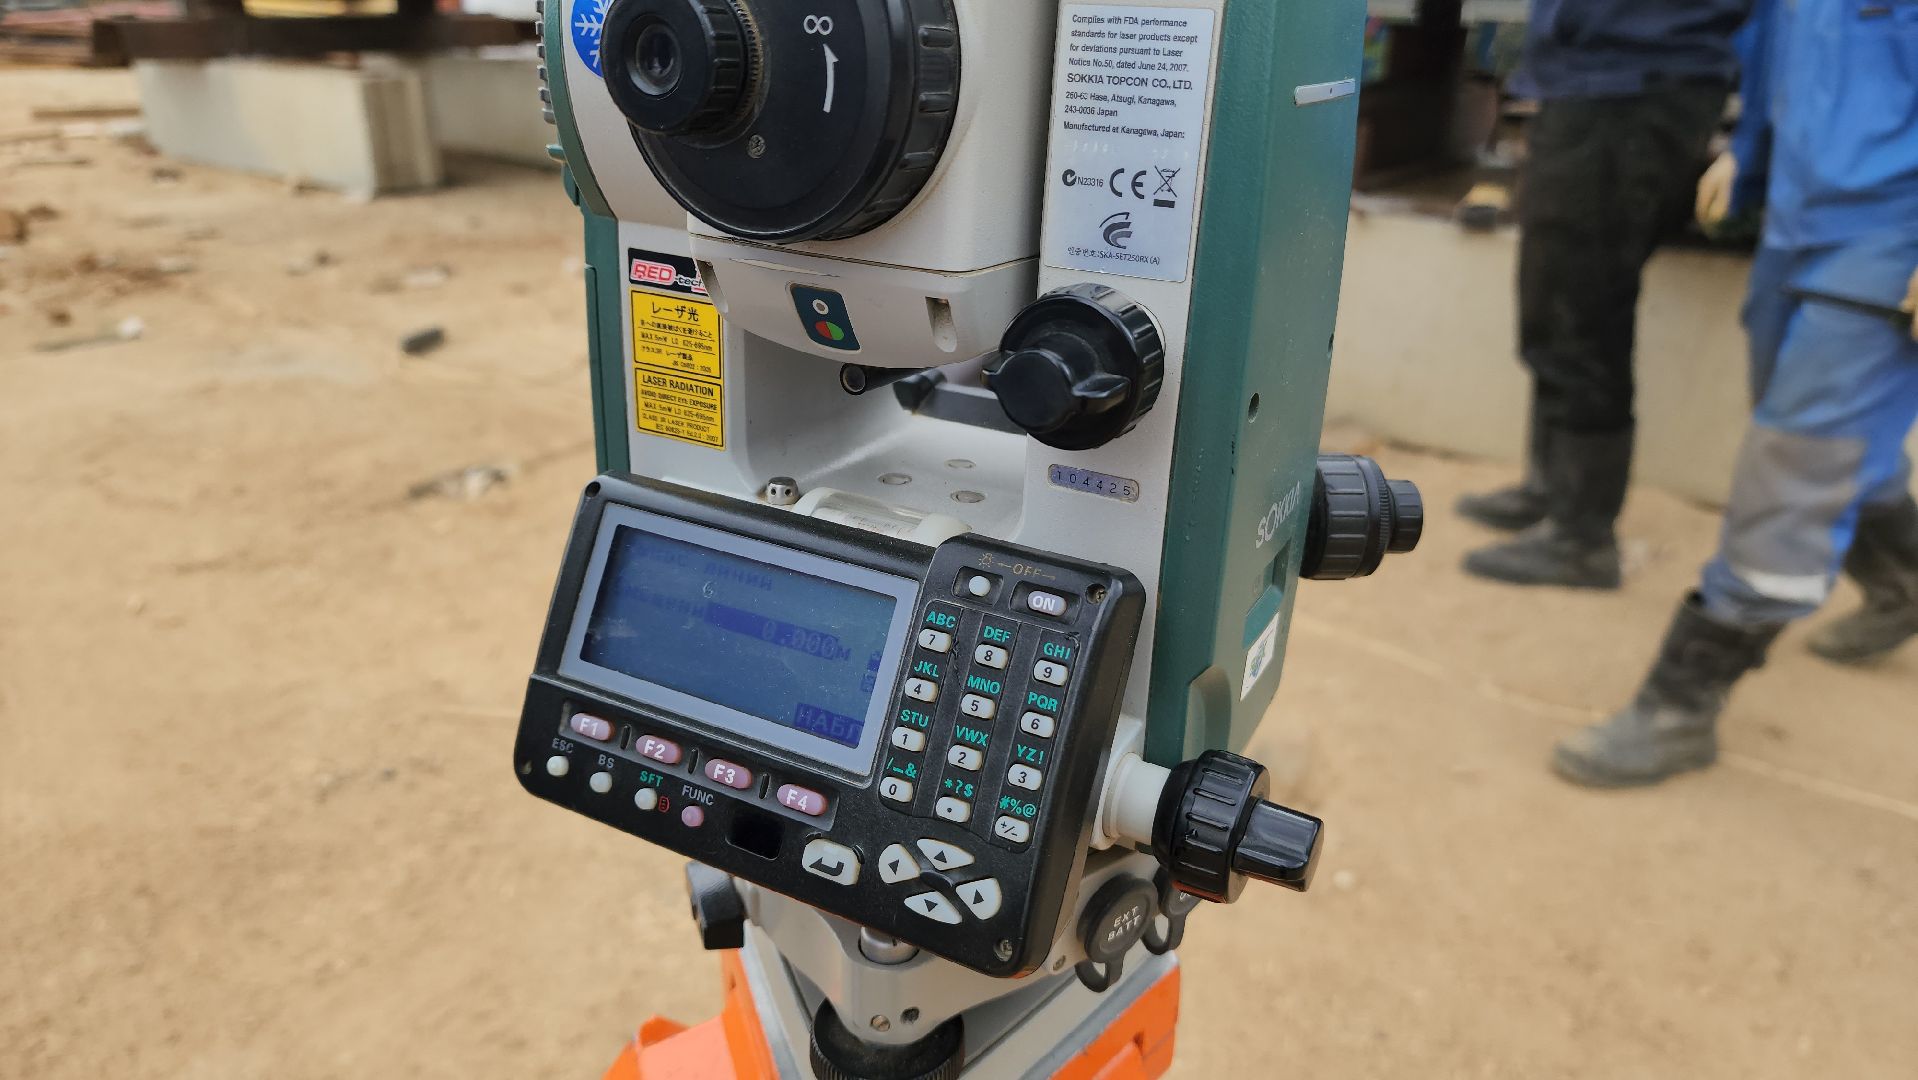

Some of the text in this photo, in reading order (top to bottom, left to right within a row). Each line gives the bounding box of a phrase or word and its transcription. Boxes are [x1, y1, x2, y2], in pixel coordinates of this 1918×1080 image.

[1072, 14, 1187, 28] Complies with FDA performance
[1071, 30, 1106, 38] standards
[1120, 32, 1136, 40] laser
[1139, 33, 1171, 42] products
[1173, 35, 1197, 44] except
[1081, 44, 1116, 54] deviations
[1119, 47, 1151, 56] pursuant
[1163, 48, 1183, 57] Laser
[1068, 57, 1090, 67] Notice
[1093, 59, 1114, 69] No.50,
[1116, 60, 1135, 70] dated
[1138, 61, 1155, 71] June
[1169, 63, 1189, 72] 2007.
[1067, 73, 1193, 90] SOKKIA TOPCON CO., LTD.
[1090, 93, 1110, 103] Hase,
[1111, 94, 1135, 105] Atsugi,
[1138, 96, 1176, 107] Kanagawa,
[1065, 105, 1117, 117] 243-0036 Japan
[1064, 121, 1110, 133] Manufactured
[1112, 125, 1118, 133] at
[1121, 126, 1159, 138] Kanagawa,
[1078, 168, 1147, 199] N23316 CE
[652, 301, 699, 321] レーザ光
[642, 374, 713, 397] LASER RADIATION
[689, 398, 717, 410] EXPOSURE
[1013, 563, 1041, 578] OFF
[1033, 595, 1054, 611] ON
[926, 611, 956, 629] ABC
[929, 634, 936, 645] 7
[983, 625, 1011, 643] DEF
[984, 650, 993, 661] 8
[1043, 643, 1070, 660] GHI
[914, 660, 939, 678] JKL
[1043, 666, 1052, 678] 9
[914, 684, 921, 695] 4
[968, 675, 1000, 694] MNO
[971, 700, 979, 711] 5
[1028, 692, 1058, 712] PQR
[900, 709, 929, 728] STU
[1031, 718, 1039, 729] 6
[578, 721, 598, 736] F1
[956, 725, 988, 747] VWX
[552, 738, 574, 754] ESC
[902, 734, 908, 745] 1
[643, 740, 665, 760] F2
[1017, 744, 1044, 764] YZ!
[598, 754, 614, 769] BS
[957, 752, 967, 765] 2
[639, 771, 664, 788] SFT
[713, 763, 735, 784] F3
[1018, 772, 1026, 784] 3
[682, 784, 714, 806] FUNC
[889, 784, 897, 795] 0
[786, 788, 808, 809] F4
[1114, 905, 1139, 928] EXT
[1108, 915, 1141, 942] BATT
